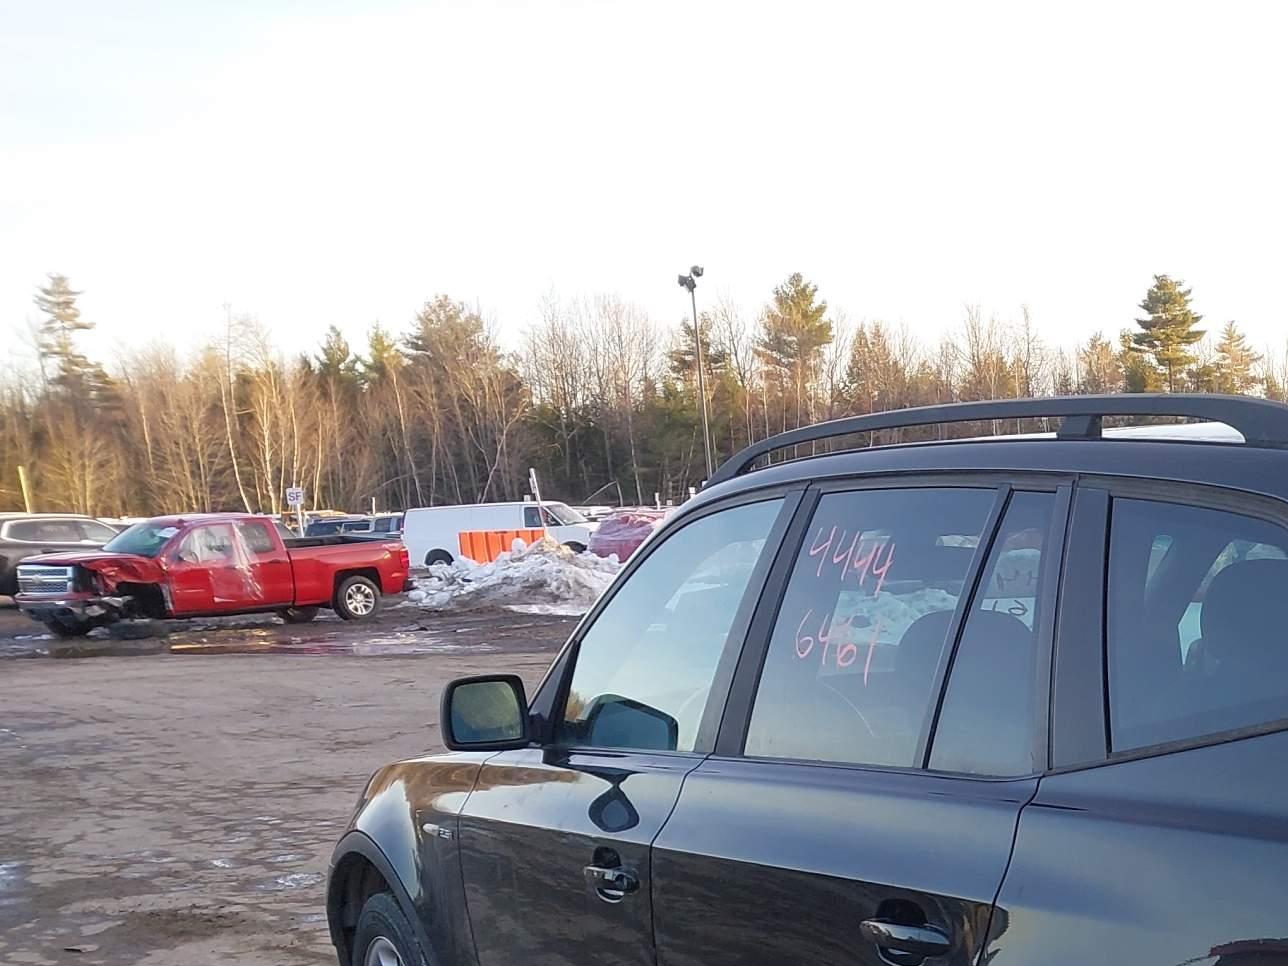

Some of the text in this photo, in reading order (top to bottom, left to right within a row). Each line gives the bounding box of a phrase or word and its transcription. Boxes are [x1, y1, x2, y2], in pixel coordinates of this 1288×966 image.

[288, 491, 302, 502] SF
[808, 525, 896, 599] 4444
[794, 608, 882, 688] 6461
